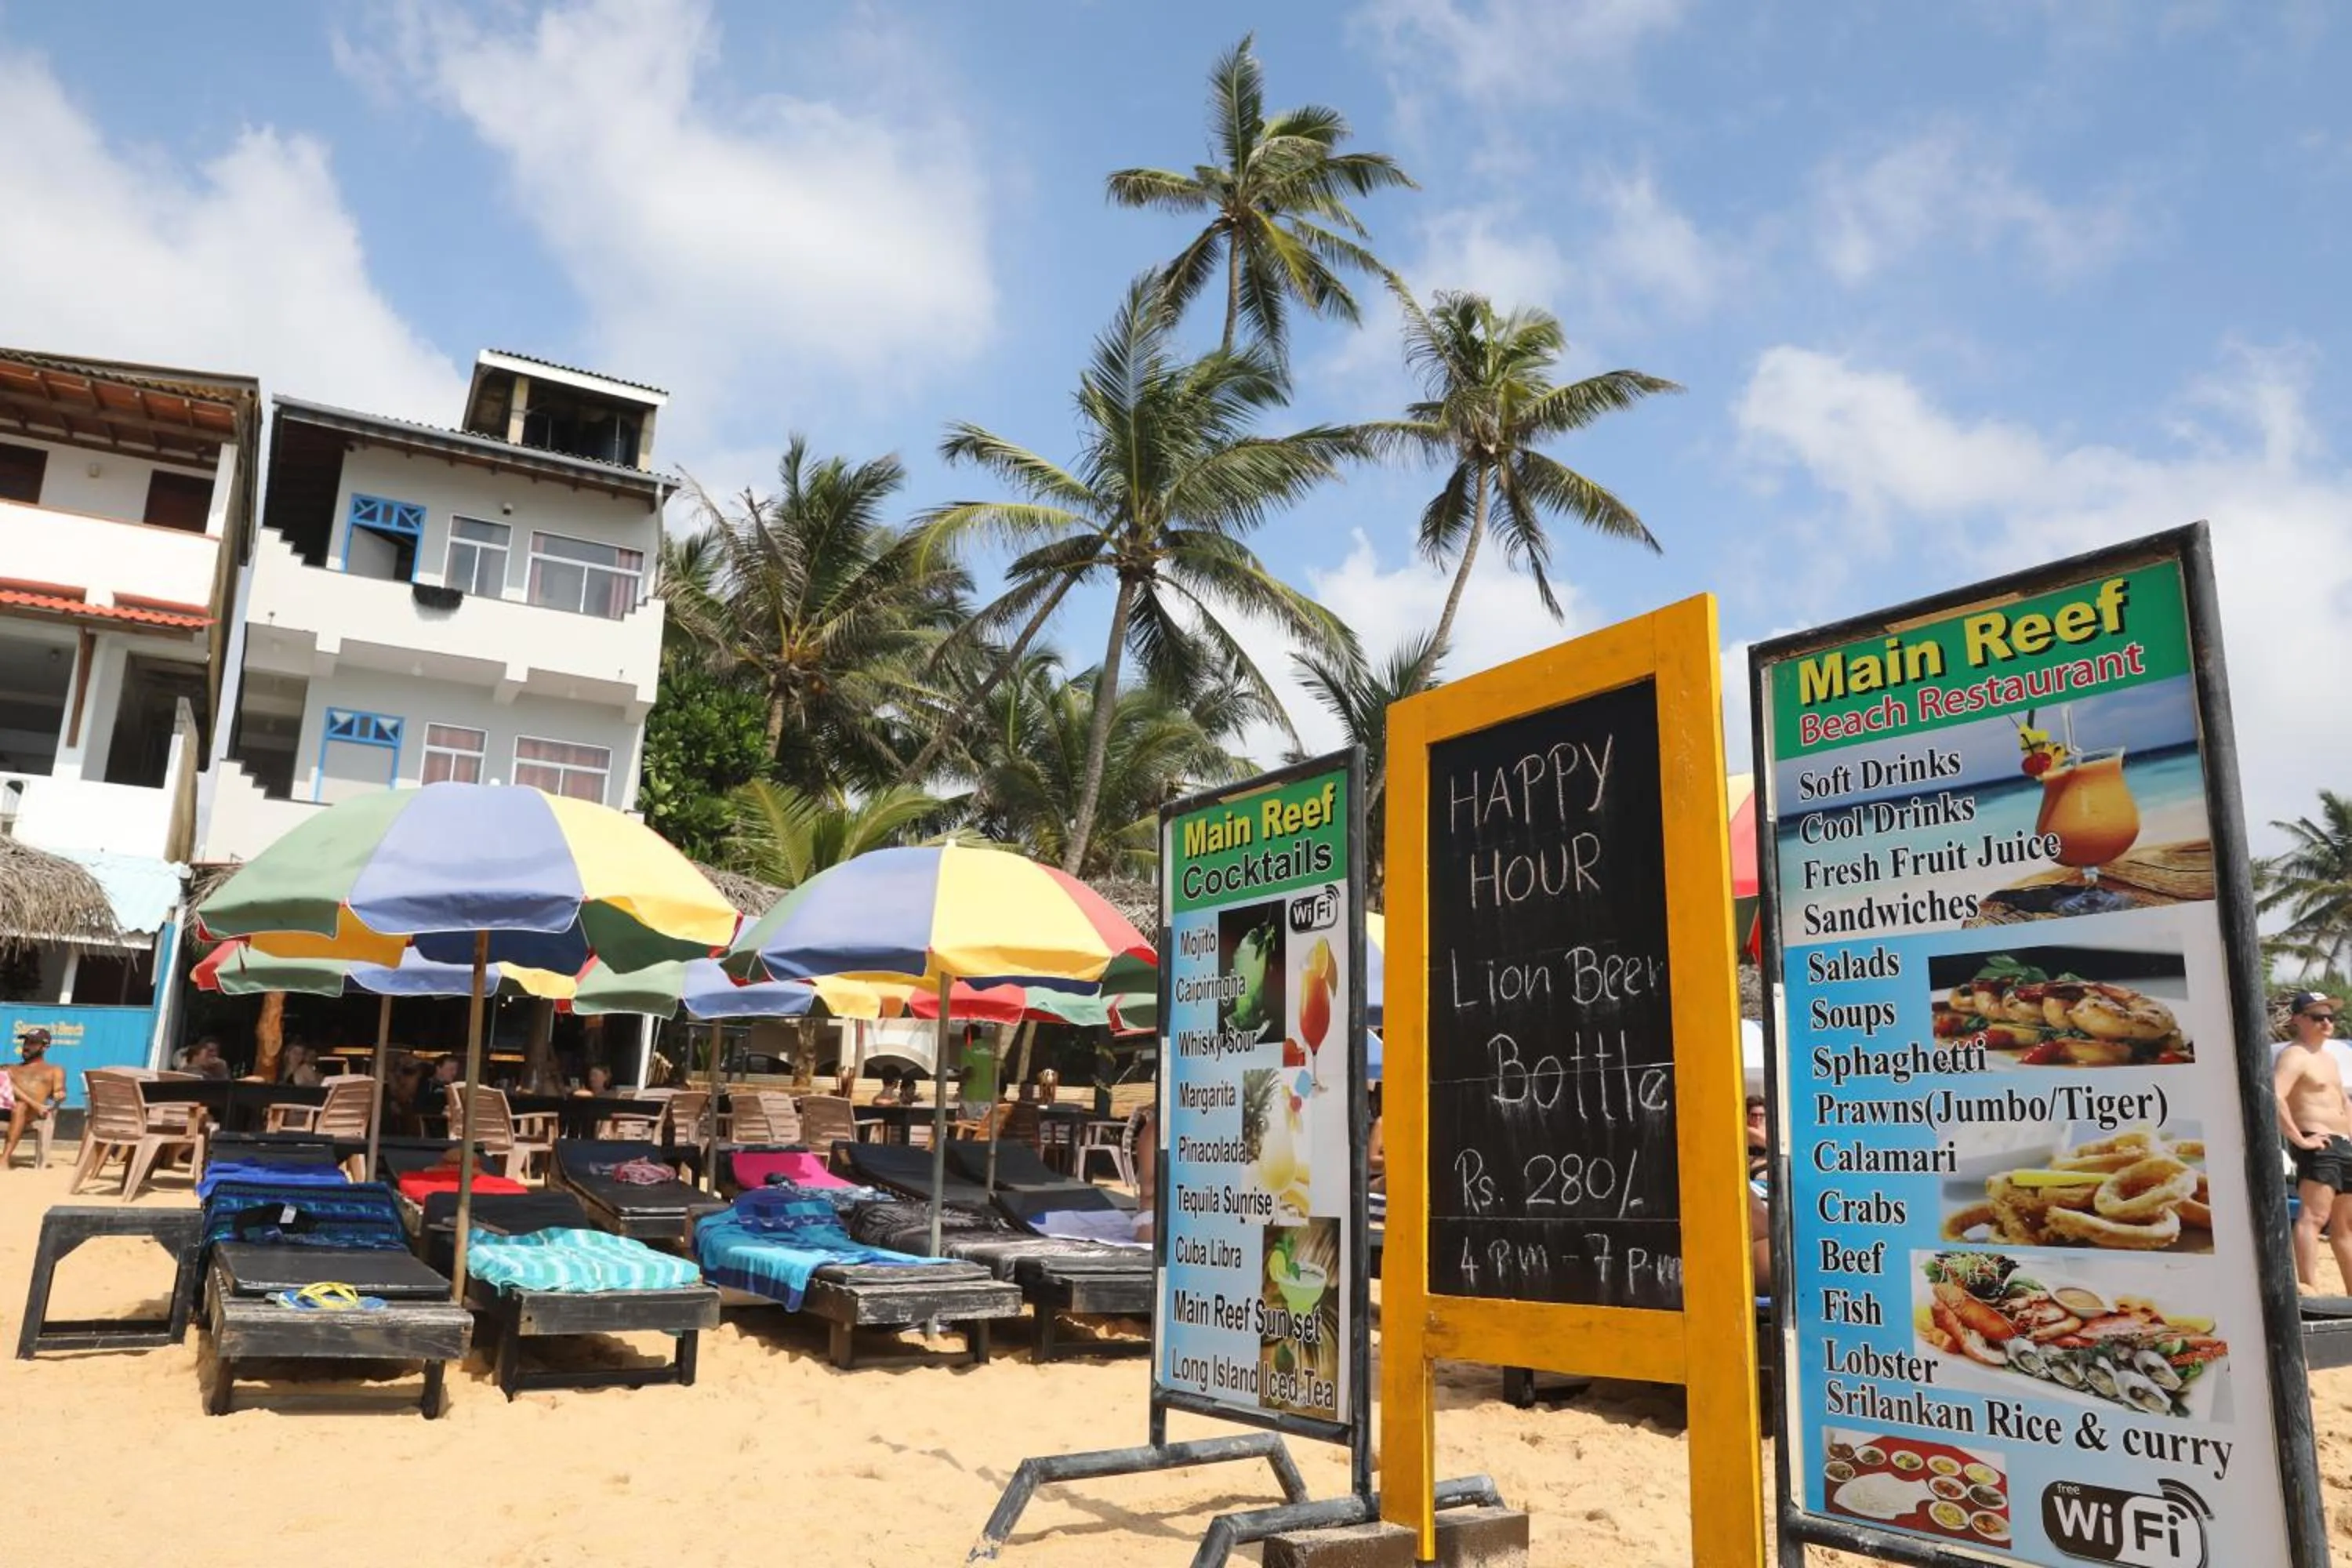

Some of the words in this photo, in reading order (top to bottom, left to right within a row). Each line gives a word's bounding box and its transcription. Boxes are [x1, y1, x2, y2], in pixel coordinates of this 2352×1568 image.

[1798, 638, 1945, 706] Main
[1964, 578, 2129, 669] Reef
[1800, 695, 1906, 746] Beach
[1920, 642, 2145, 720] Restaurant
[1451, 734, 1613, 834] HAPPY
[1799, 765, 1851, 801] Soft
[1861, 749, 1961, 789] Drinks
[1184, 811, 1252, 858] Main
[1261, 782, 1336, 839] Reef
[1801, 806, 1863, 844] Cool
[1874, 794, 1975, 833] Drinks
[1182, 837, 1333, 899] Cocktails
[1471, 833, 1601, 909] HOUR
[1803, 850, 1881, 890] Fresh
[1891, 840, 1968, 878] Fruit
[1976, 829, 2061, 868] Juice
[1804, 891, 1980, 936] Sandwiches
[1180, 928, 1216, 961] Mojito
[1808, 949, 1900, 983] Salads
[1452, 948, 1551, 1007] Lion
[1811, 999, 1896, 1035] Soups
[1178, 1029, 1222, 1062] Whisky
[1226, 1026, 1258, 1054] Sour
[1813, 1039, 1987, 1085] Sphaghetti
[1179, 1080, 1236, 1114] Margarita
[1487, 1029, 1668, 1123] Bottle
[1815, 1084, 2169, 1131] Prawns(Jumbo/Tiger)
[1178, 1136, 1247, 1163] Pinacolada
[1813, 1140, 1958, 1174] Calamari
[1177, 1184, 1219, 1219] Tequila
[1223, 1185, 1272, 1215] Sunrise
[1818, 1189, 1907, 1225] Crabs
[1175, 1236, 1207, 1265] Cuba
[1210, 1239, 1243, 1270] Libra
[1461, 1236, 1479, 1287] 4
[1584, 1232, 1613, 1283] 7
[1819, 1240, 1885, 1274] Beef
[1174, 1290, 1209, 1325] Main
[1214, 1297, 1250, 1334] Reef
[1254, 1298, 1288, 1336] Sun
[1292, 1308, 1323, 1343] set
[1821, 1289, 1882, 1327] Fish
[1171, 1348, 1209, 1392] Long
[1213, 1353, 1259, 1395] Island
[1263, 1363, 1299, 1402] Iced
[1304, 1370, 1335, 1410] Tea
[1824, 1339, 1939, 1385] Lobster
[1827, 1381, 1974, 1433] Srilankan
[1985, 1399, 2063, 1445] Rice
[2075, 1413, 2108, 1450] &
[2122, 1428, 2234, 1479] curry
[2056, 1483, 2080, 1495] free
[2053, 1495, 2181, 1558] WiFi
